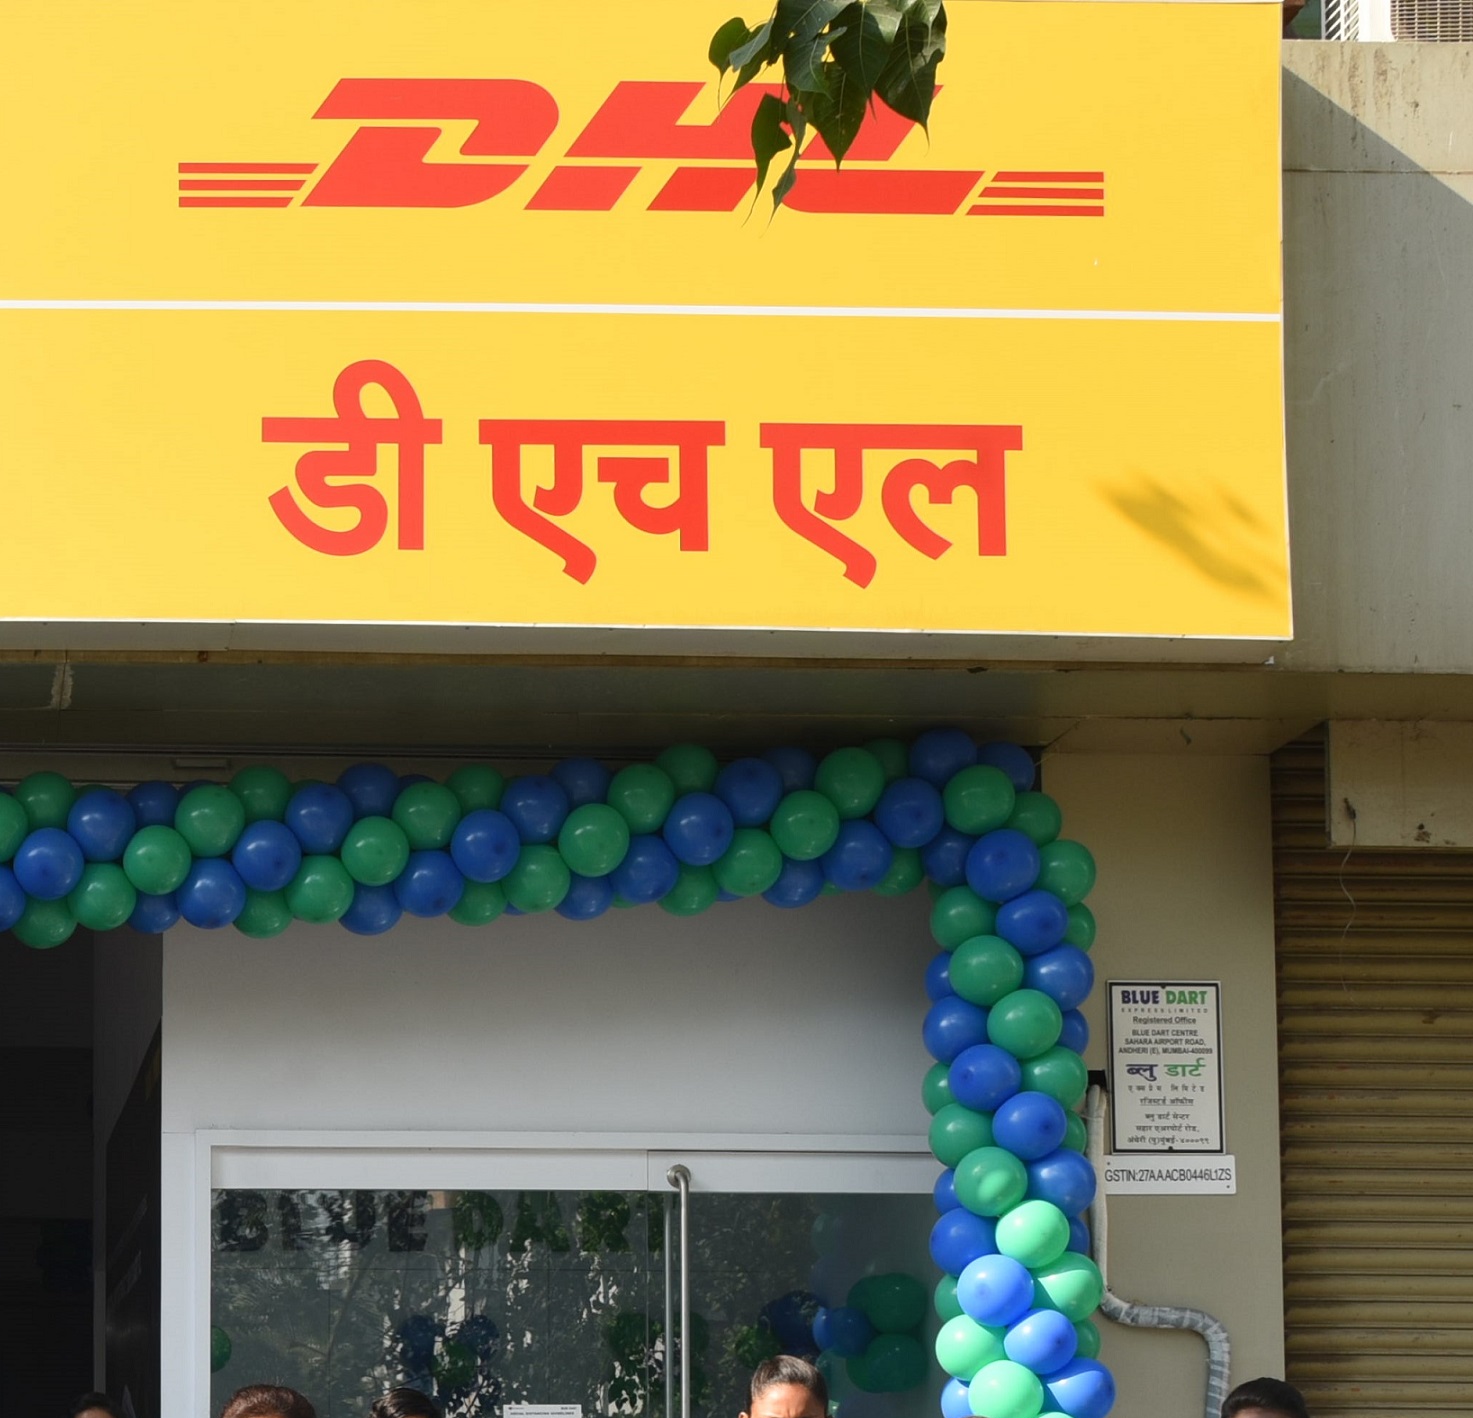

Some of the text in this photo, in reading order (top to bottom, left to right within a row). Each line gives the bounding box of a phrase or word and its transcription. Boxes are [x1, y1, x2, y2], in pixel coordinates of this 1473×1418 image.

[299, 78, 986, 217] DHL
[262, 360, 1022, 589] डी एच एल
[1121, 990, 1207, 1004] BLUE DART
[1133, 1016, 1196, 1025] Registered Office
[1125, 1057, 1206, 1081] ब्लु डार्ट
[220, 1191, 430, 1252] BLUE
